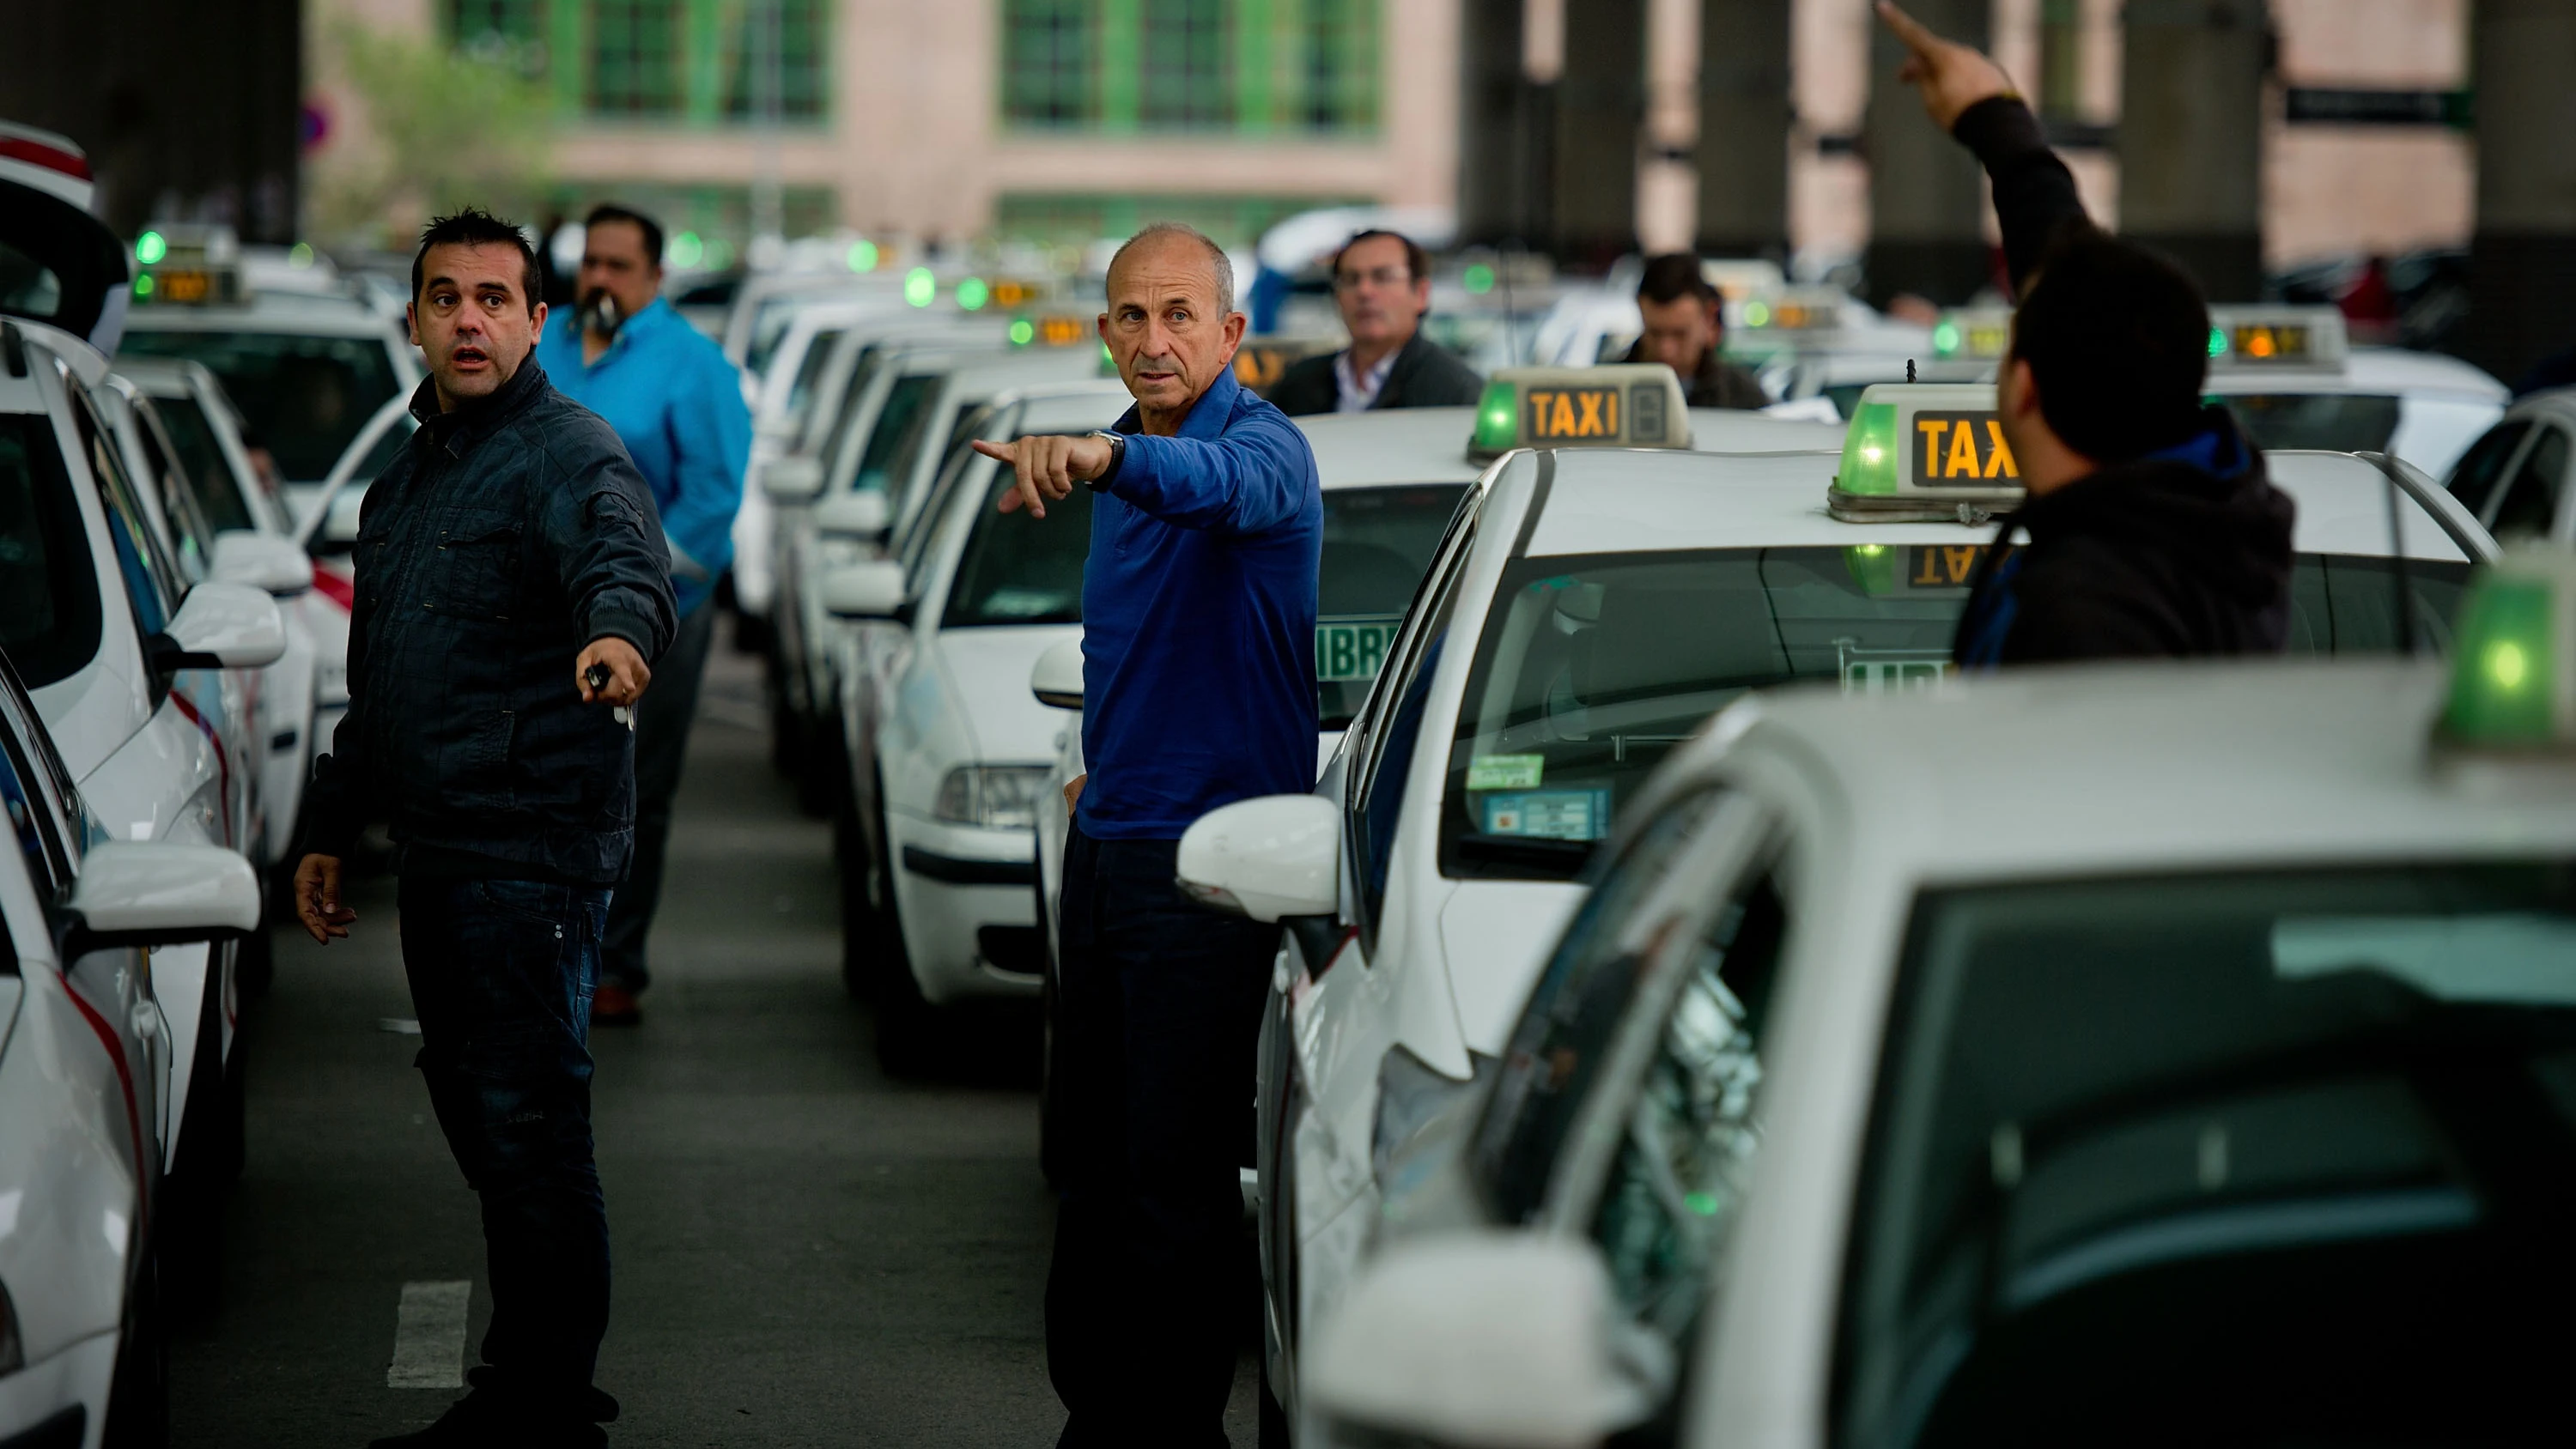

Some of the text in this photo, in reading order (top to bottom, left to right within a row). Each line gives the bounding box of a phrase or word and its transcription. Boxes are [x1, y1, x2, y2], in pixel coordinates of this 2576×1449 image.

[1528, 391, 1619, 437] TAXI
[1917, 419, 2020, 479] TAX
[1317, 627, 1398, 676] IBR
